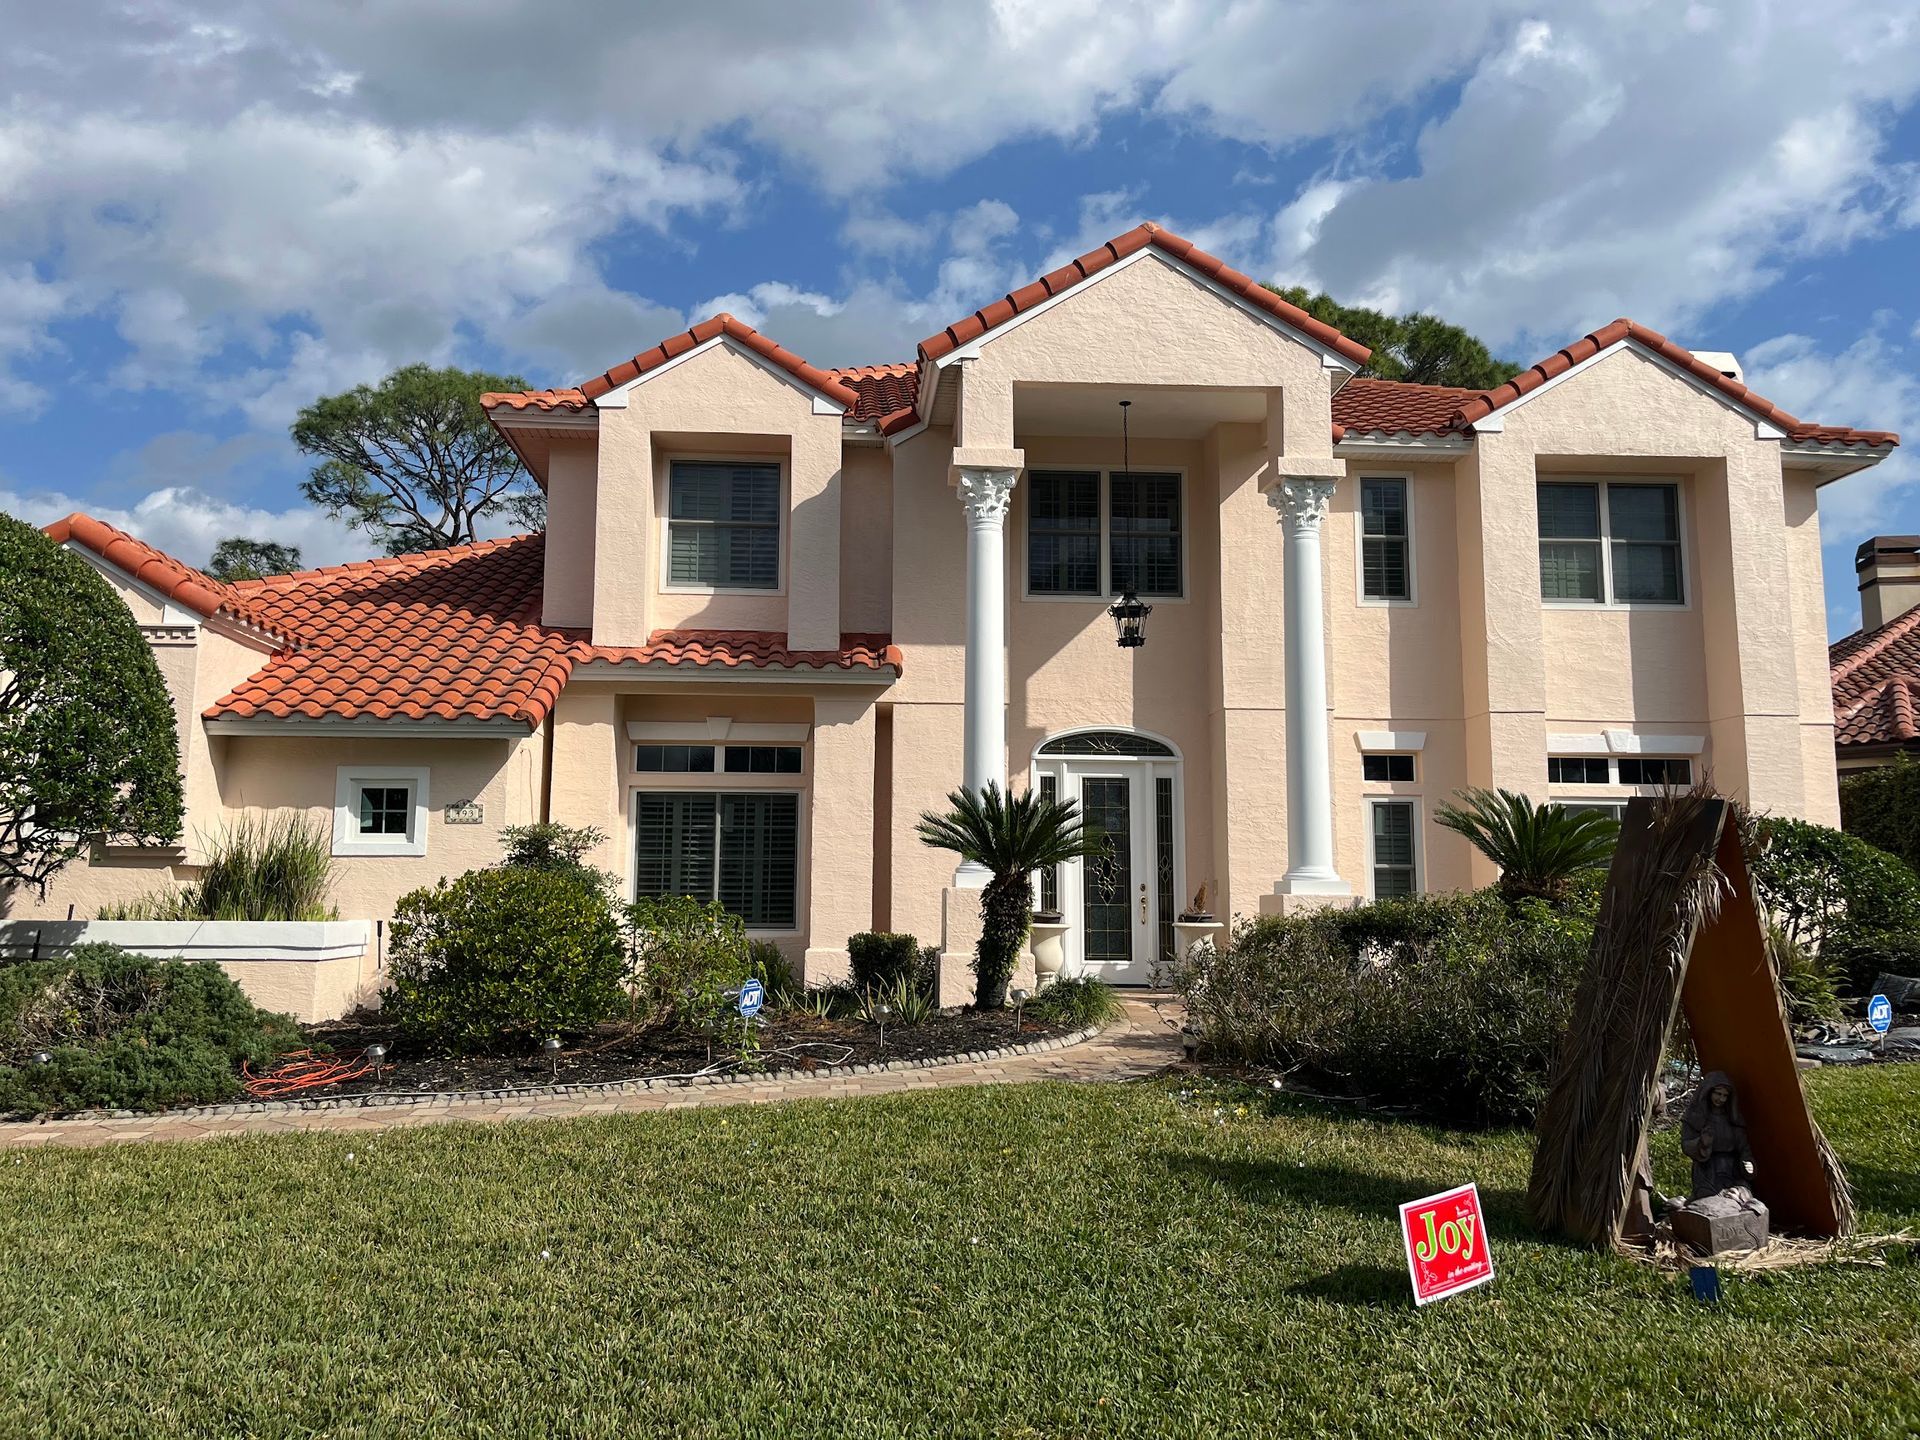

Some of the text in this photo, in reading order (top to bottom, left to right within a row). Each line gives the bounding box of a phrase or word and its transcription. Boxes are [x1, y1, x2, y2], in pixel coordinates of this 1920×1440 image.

[741, 990, 760, 1007] ADT
[1872, 1004, 1889, 1020] ADT
[1415, 1210, 1476, 1262] Joy
